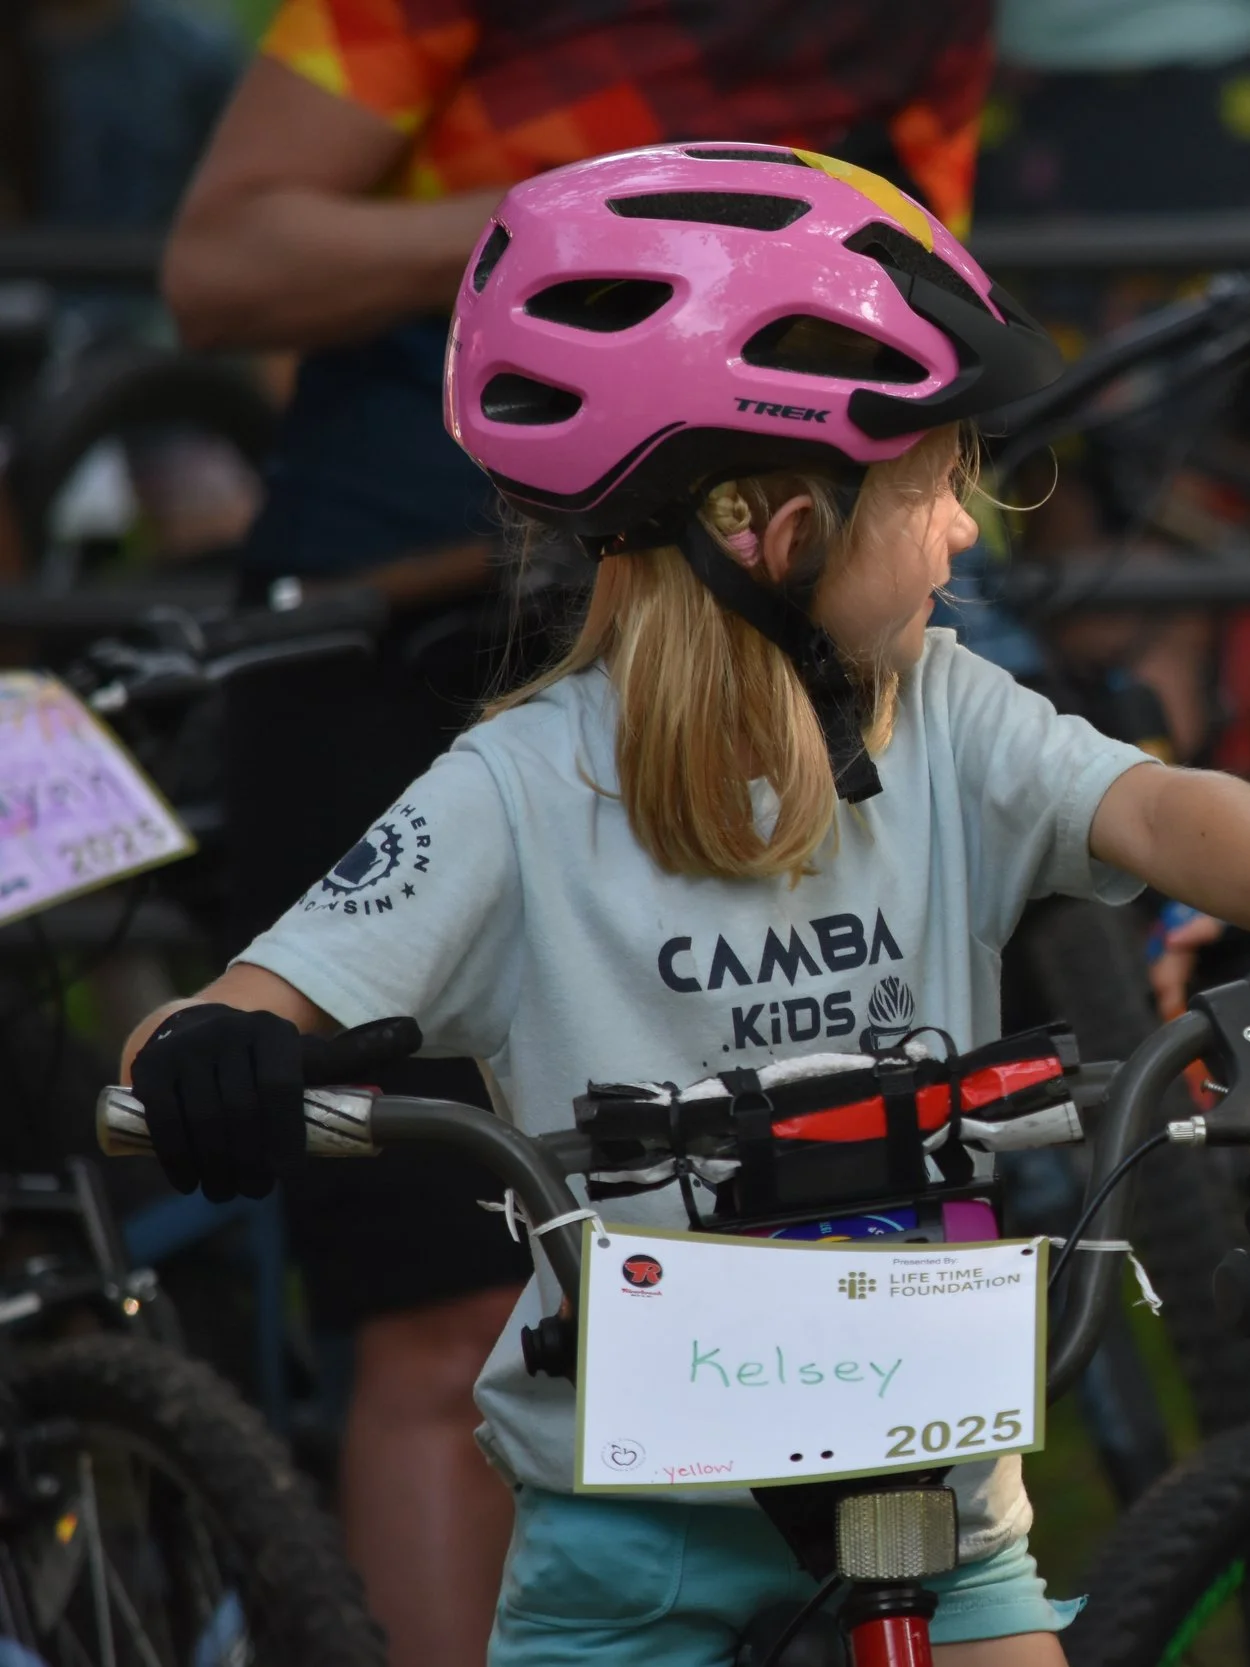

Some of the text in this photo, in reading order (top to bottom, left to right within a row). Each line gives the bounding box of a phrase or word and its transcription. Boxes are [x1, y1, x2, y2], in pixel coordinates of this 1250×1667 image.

[734, 397, 832, 423] TREK
[657, 906, 904, 994] CAMBA
[892, 1257, 941, 1266] Presented
[890, 1267, 983, 1285] LIFE TIME
[890, 1273, 1021, 1298] FOUNDATION
[690, 1339, 903, 1399] Kelsey
[884, 1409, 1022, 1459] 2025
[663, 1460, 734, 1485] yellow
